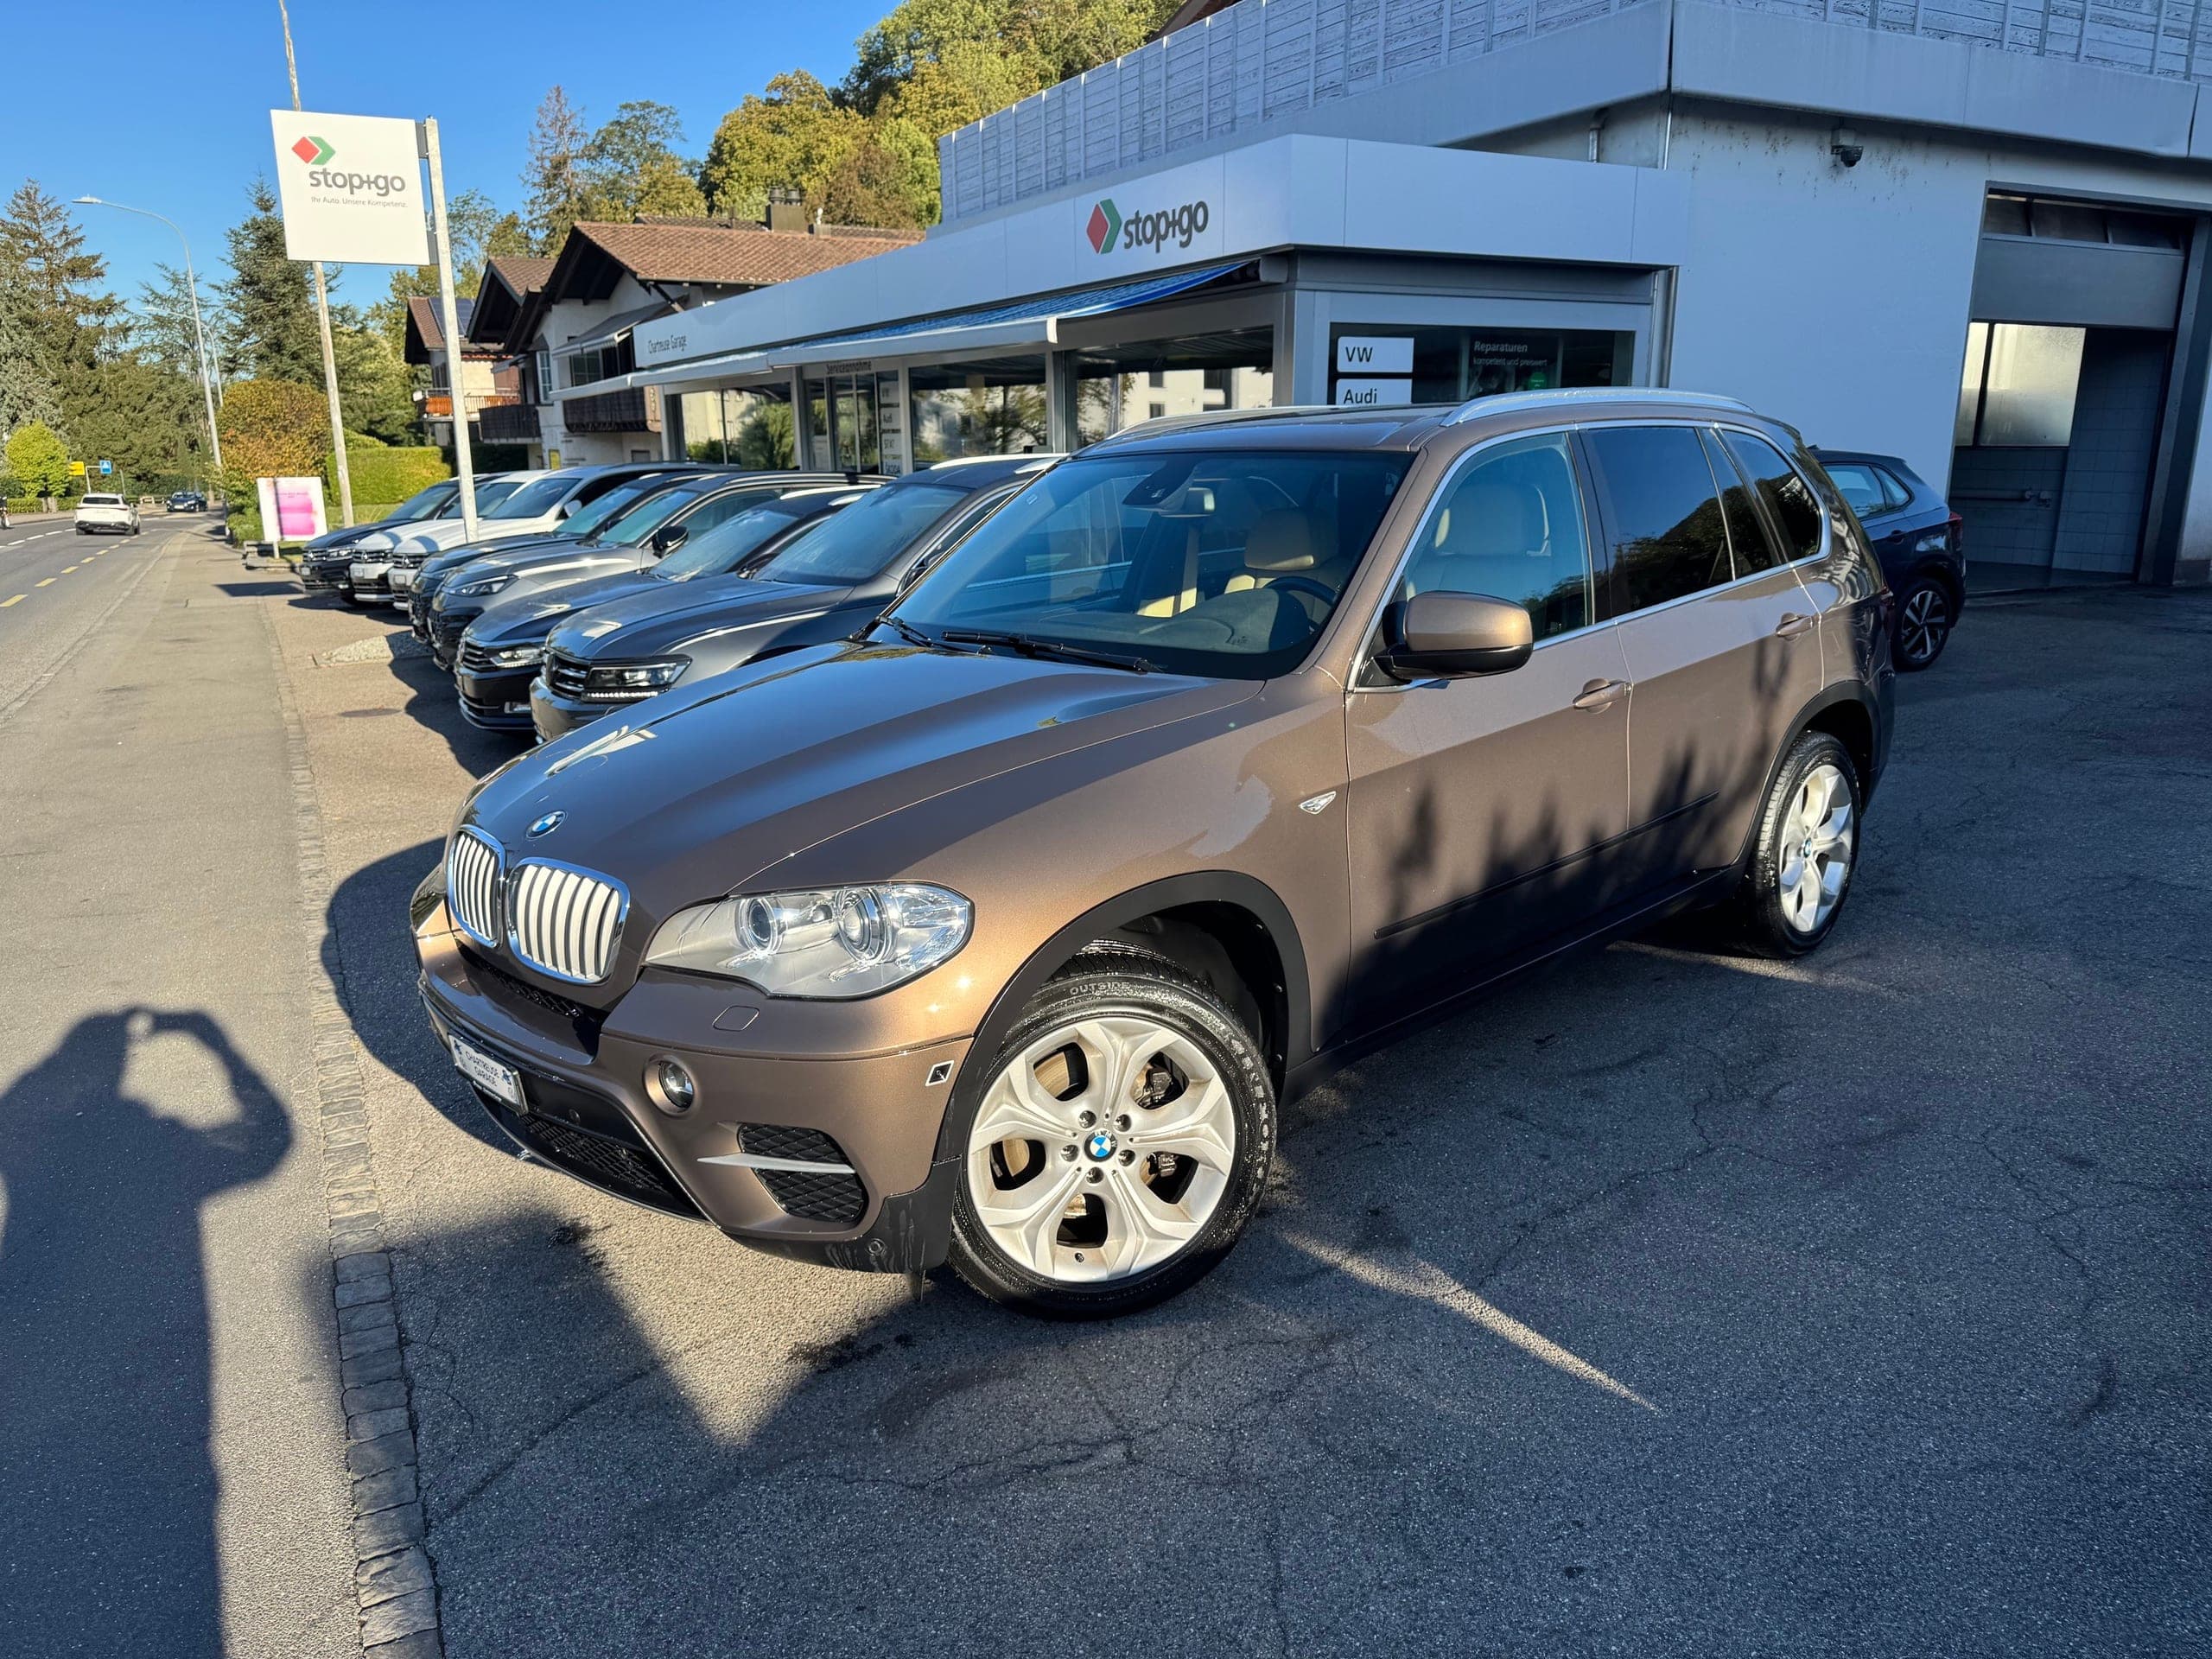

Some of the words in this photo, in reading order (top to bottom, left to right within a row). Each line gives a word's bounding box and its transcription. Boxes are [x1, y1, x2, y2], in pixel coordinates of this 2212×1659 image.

[308, 168, 406, 197] stop+go
[1124, 200, 1209, 253] stop+go
[671, 334, 687, 352] Garage
[1473, 340, 1528, 353] Reparaturen
[1345, 346, 1372, 363] VW
[1473, 356, 1506, 366] kompetent
[1507, 357, 1519, 365] und
[1344, 388, 1377, 404] Audi
[1070, 982, 1129, 995] OUTSIDE
